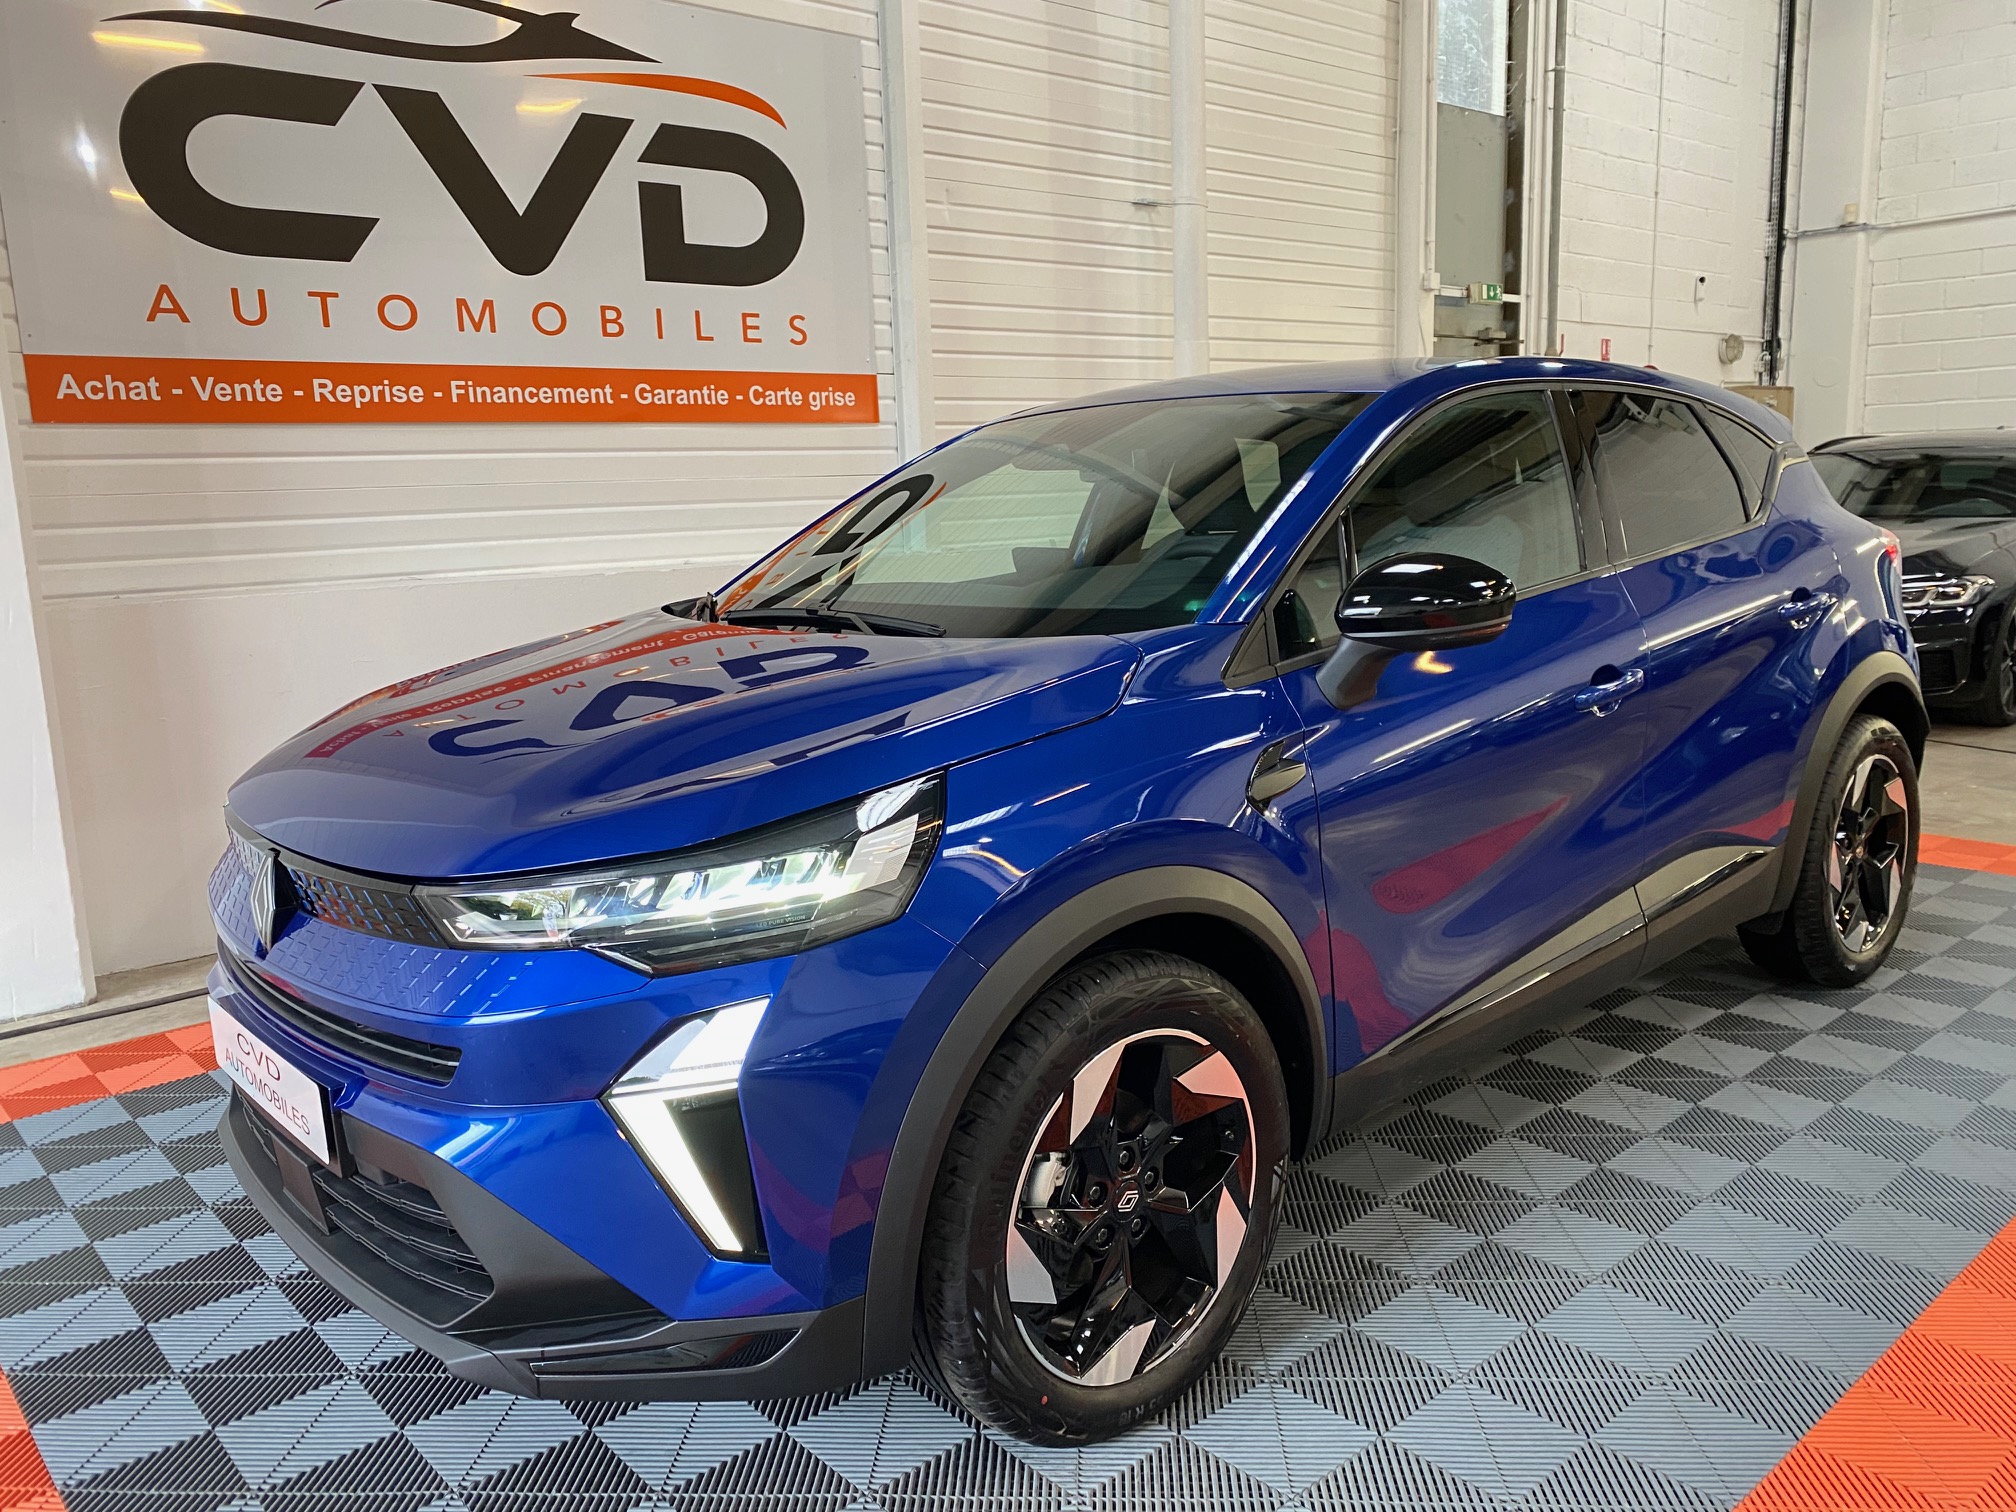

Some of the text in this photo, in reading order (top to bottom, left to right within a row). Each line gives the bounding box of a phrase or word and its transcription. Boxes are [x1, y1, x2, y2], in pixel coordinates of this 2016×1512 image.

[119, 63, 804, 286] CVD
[146, 284, 809, 346] AUTOMOBILES
[57, 374, 161, 401] Achat
[191, 377, 283, 402] Vente
[312, 379, 424, 408] Reprise
[450, 380, 614, 404] Financement
[635, 384, 729, 405] Garantie
[749, 386, 803, 406] Carte
[808, 387, 856, 411] grise
[236, 1033, 281, 1082] CVD
[225, 1047, 311, 1136] AUTOMOBILES
